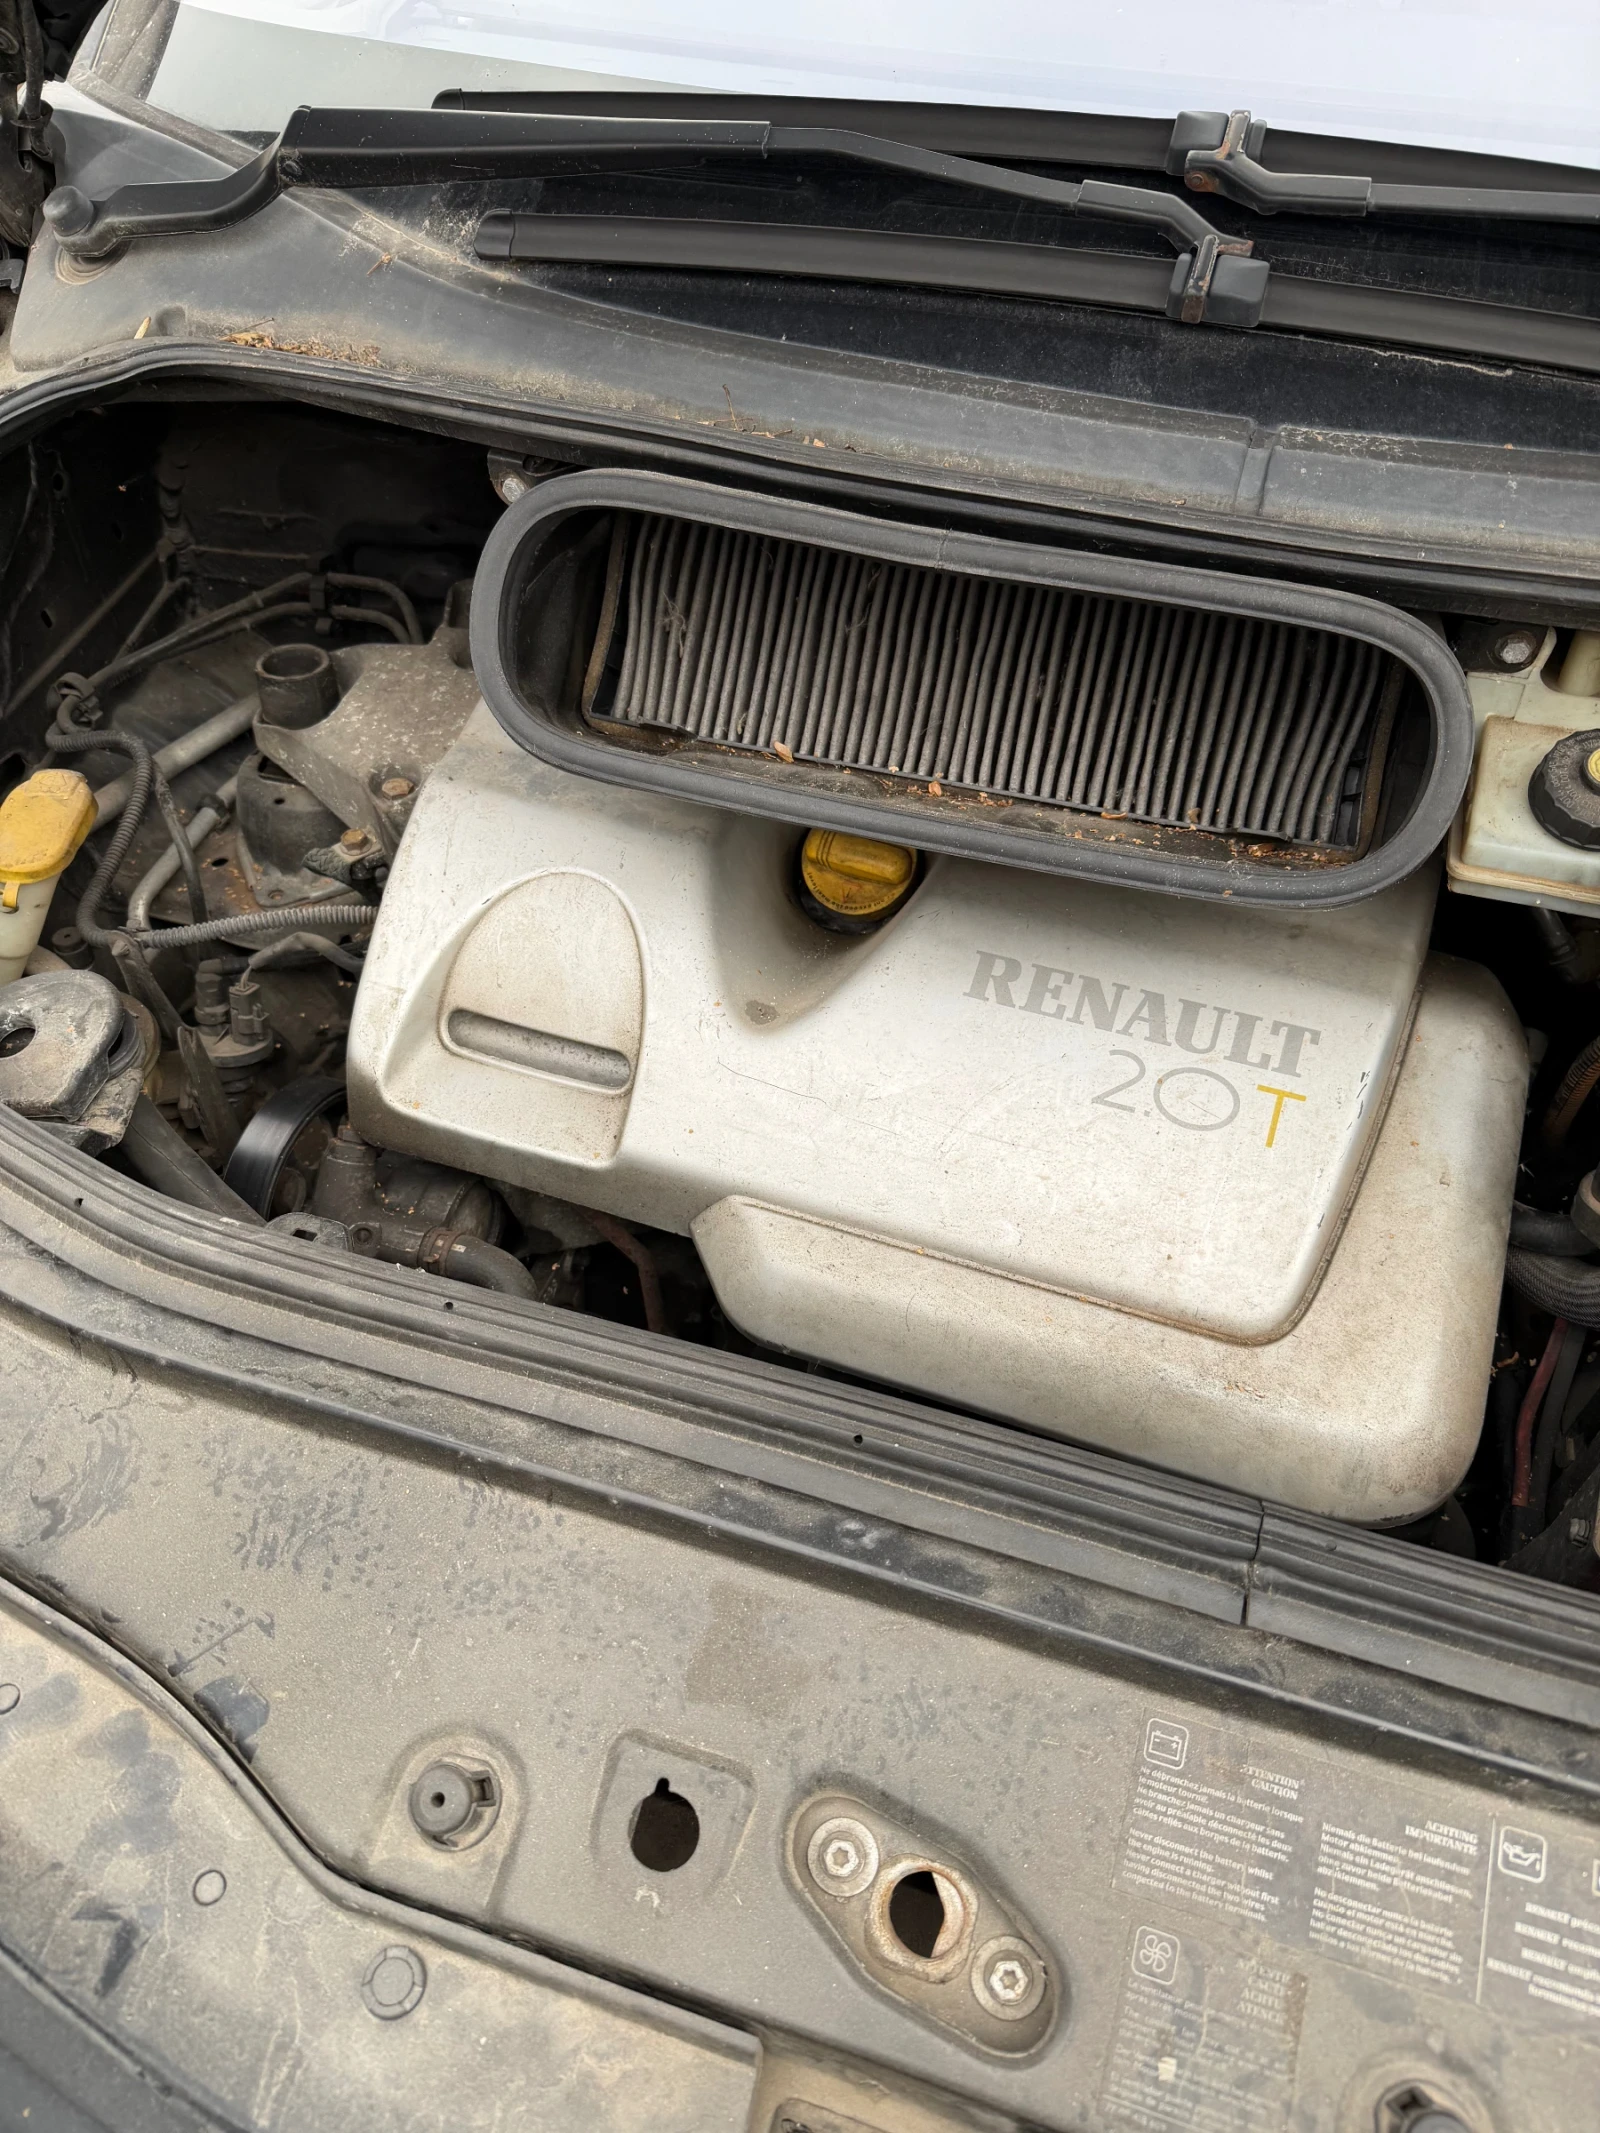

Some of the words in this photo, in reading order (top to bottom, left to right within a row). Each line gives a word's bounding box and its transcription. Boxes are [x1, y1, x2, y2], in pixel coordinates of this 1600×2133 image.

[963, 950, 1321, 1077] RENAULT
[1139, 1776, 1146, 1784] le
[1147, 1779, 1177, 1793] moteur
[1140, 1765, 1151, 1775] Ne
[1199, 1784, 1226, 1800] jamais
[1227, 1793, 1235, 1801] la
[1272, 1807, 1303, 1825] lorsque
[1251, 1778, 1298, 1800] CAUTION
[1137, 1786, 1147, 1795] Ne
[1149, 1790, 1187, 1807] branchez
[1187, 1802, 1214, 1817] jamais
[1266, 1828, 1285, 1838] sans
[1128, 1838, 1141, 1848] the
[1143, 1843, 1170, 1859] engine
[1172, 1852, 1178, 1860] is
[1130, 1828, 1153, 1841] Never
[1154, 1835, 1198, 1855] disconnect
[1200, 1850, 1214, 1860] the
[1425, 1820, 1478, 1845] ACHTUNG
[1124, 1859, 1150, 1875] having
[1151, 1868, 1206, 1891] disconnected
[1224, 1891, 1240, 1902] two
[1126, 1849, 1151, 1863] Never
[1151, 1857, 1184, 1873] connect
[1192, 1871, 1226, 1888] charger
[1262, 1893, 1279, 1904] first
